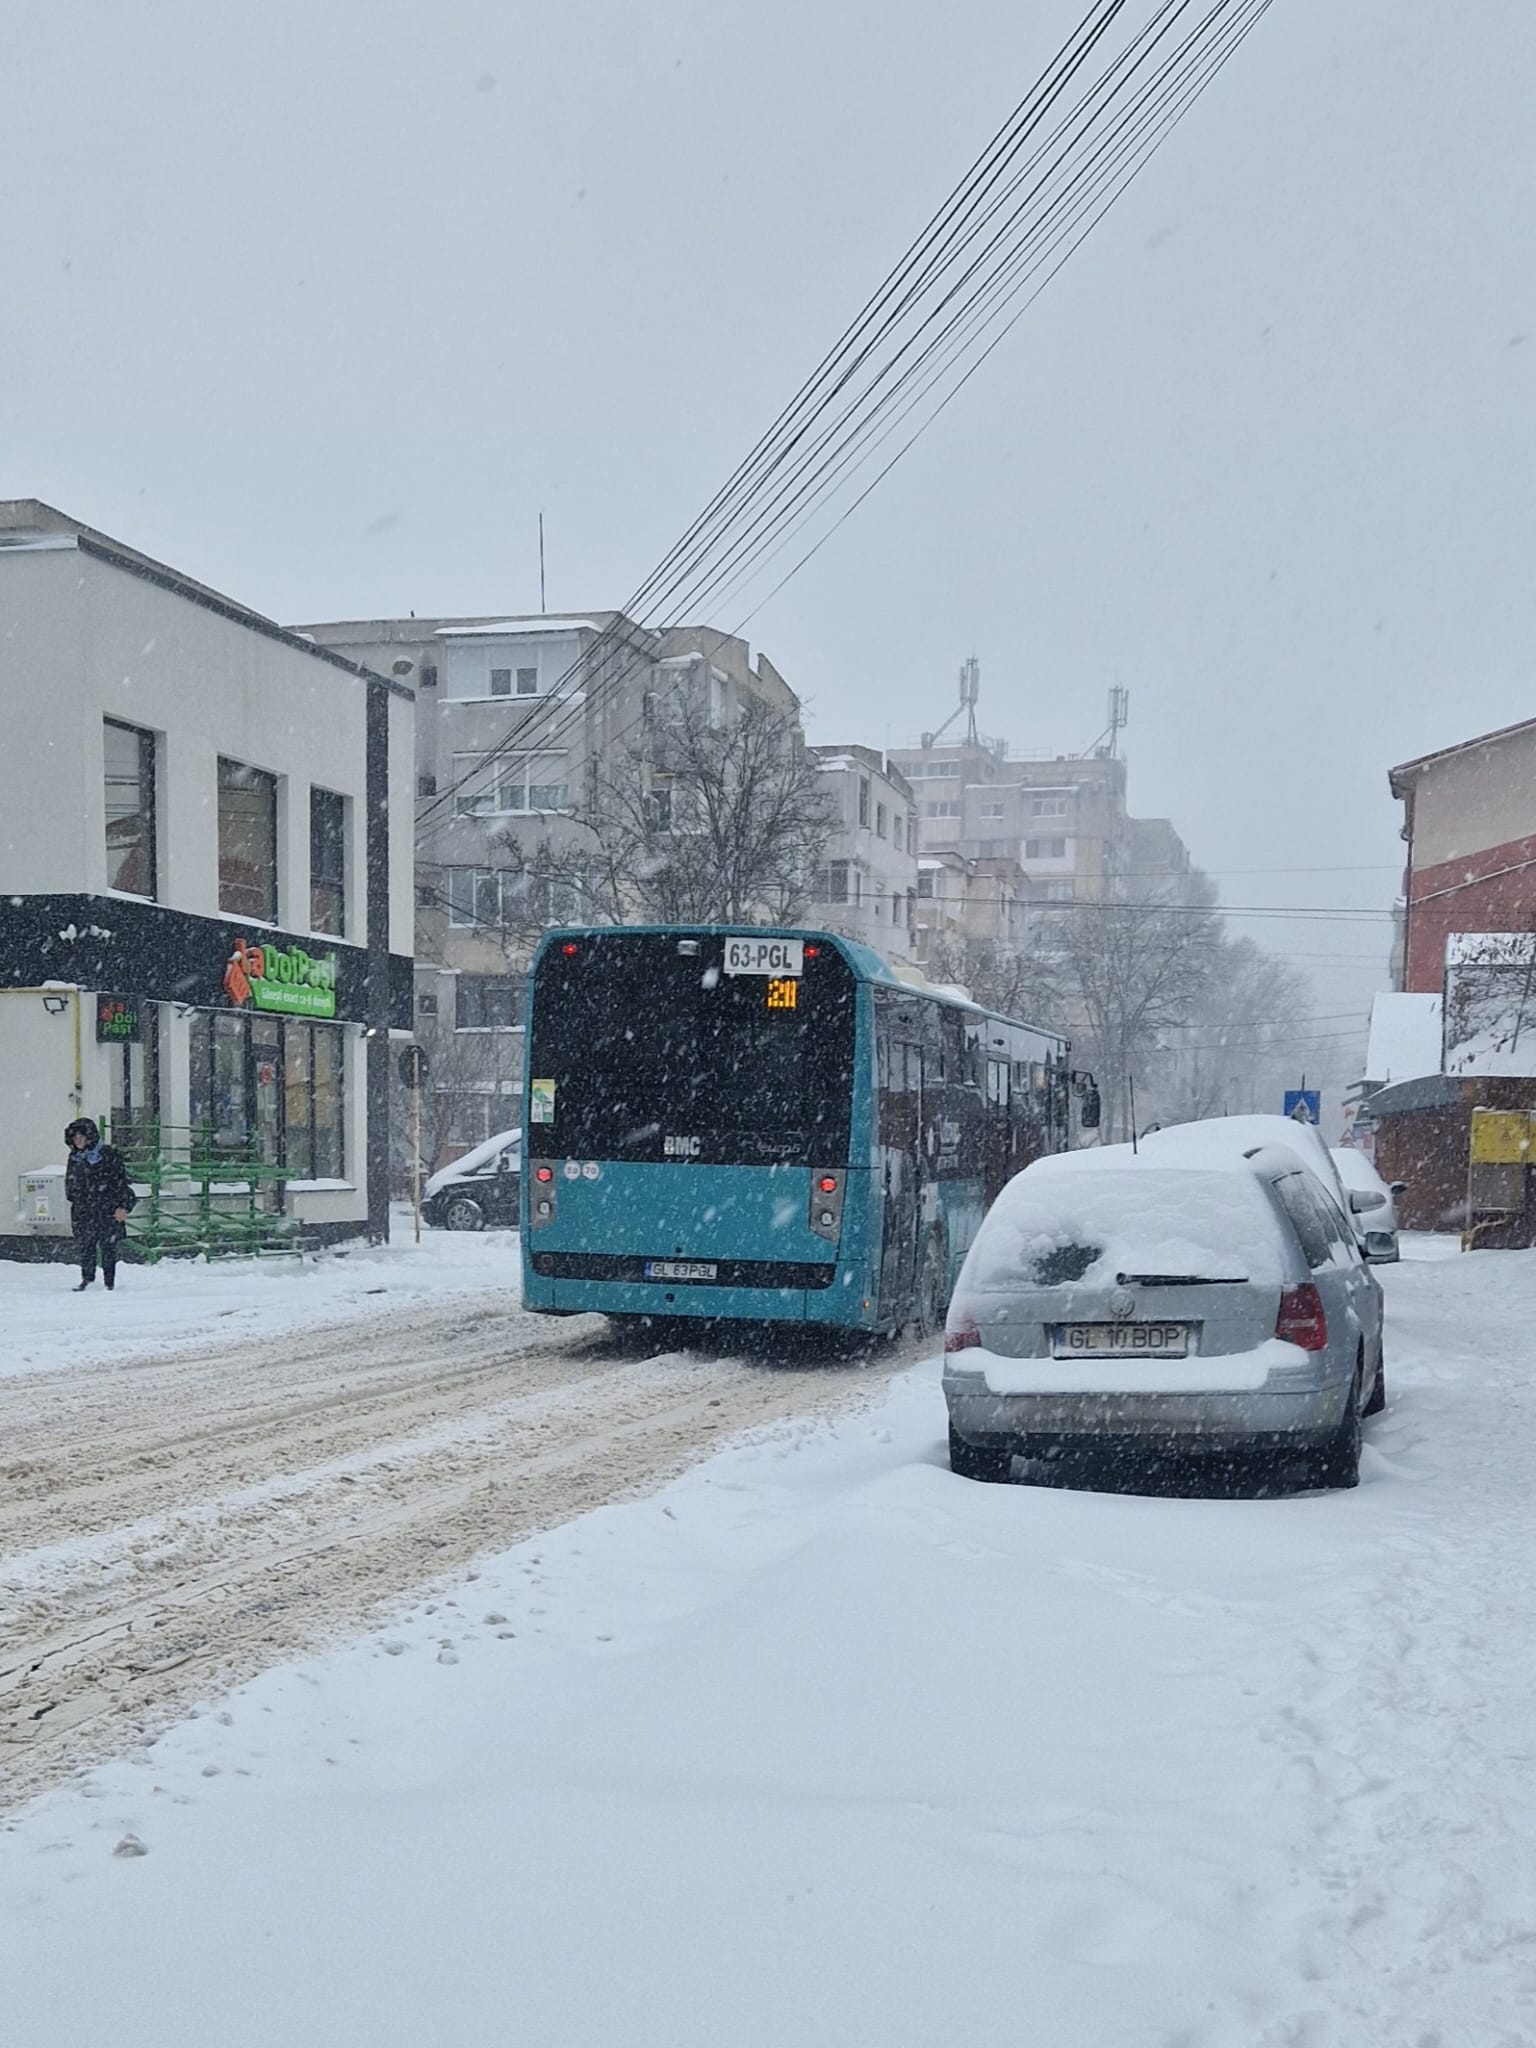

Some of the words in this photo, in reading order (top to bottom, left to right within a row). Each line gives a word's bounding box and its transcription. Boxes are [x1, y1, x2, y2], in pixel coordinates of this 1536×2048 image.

[729, 943, 793, 969] 63-PGL
[664, 1136, 700, 1156] BMC
[1070, 1328, 1097, 1349] GL
[1132, 1328, 1180, 1348] BDP
